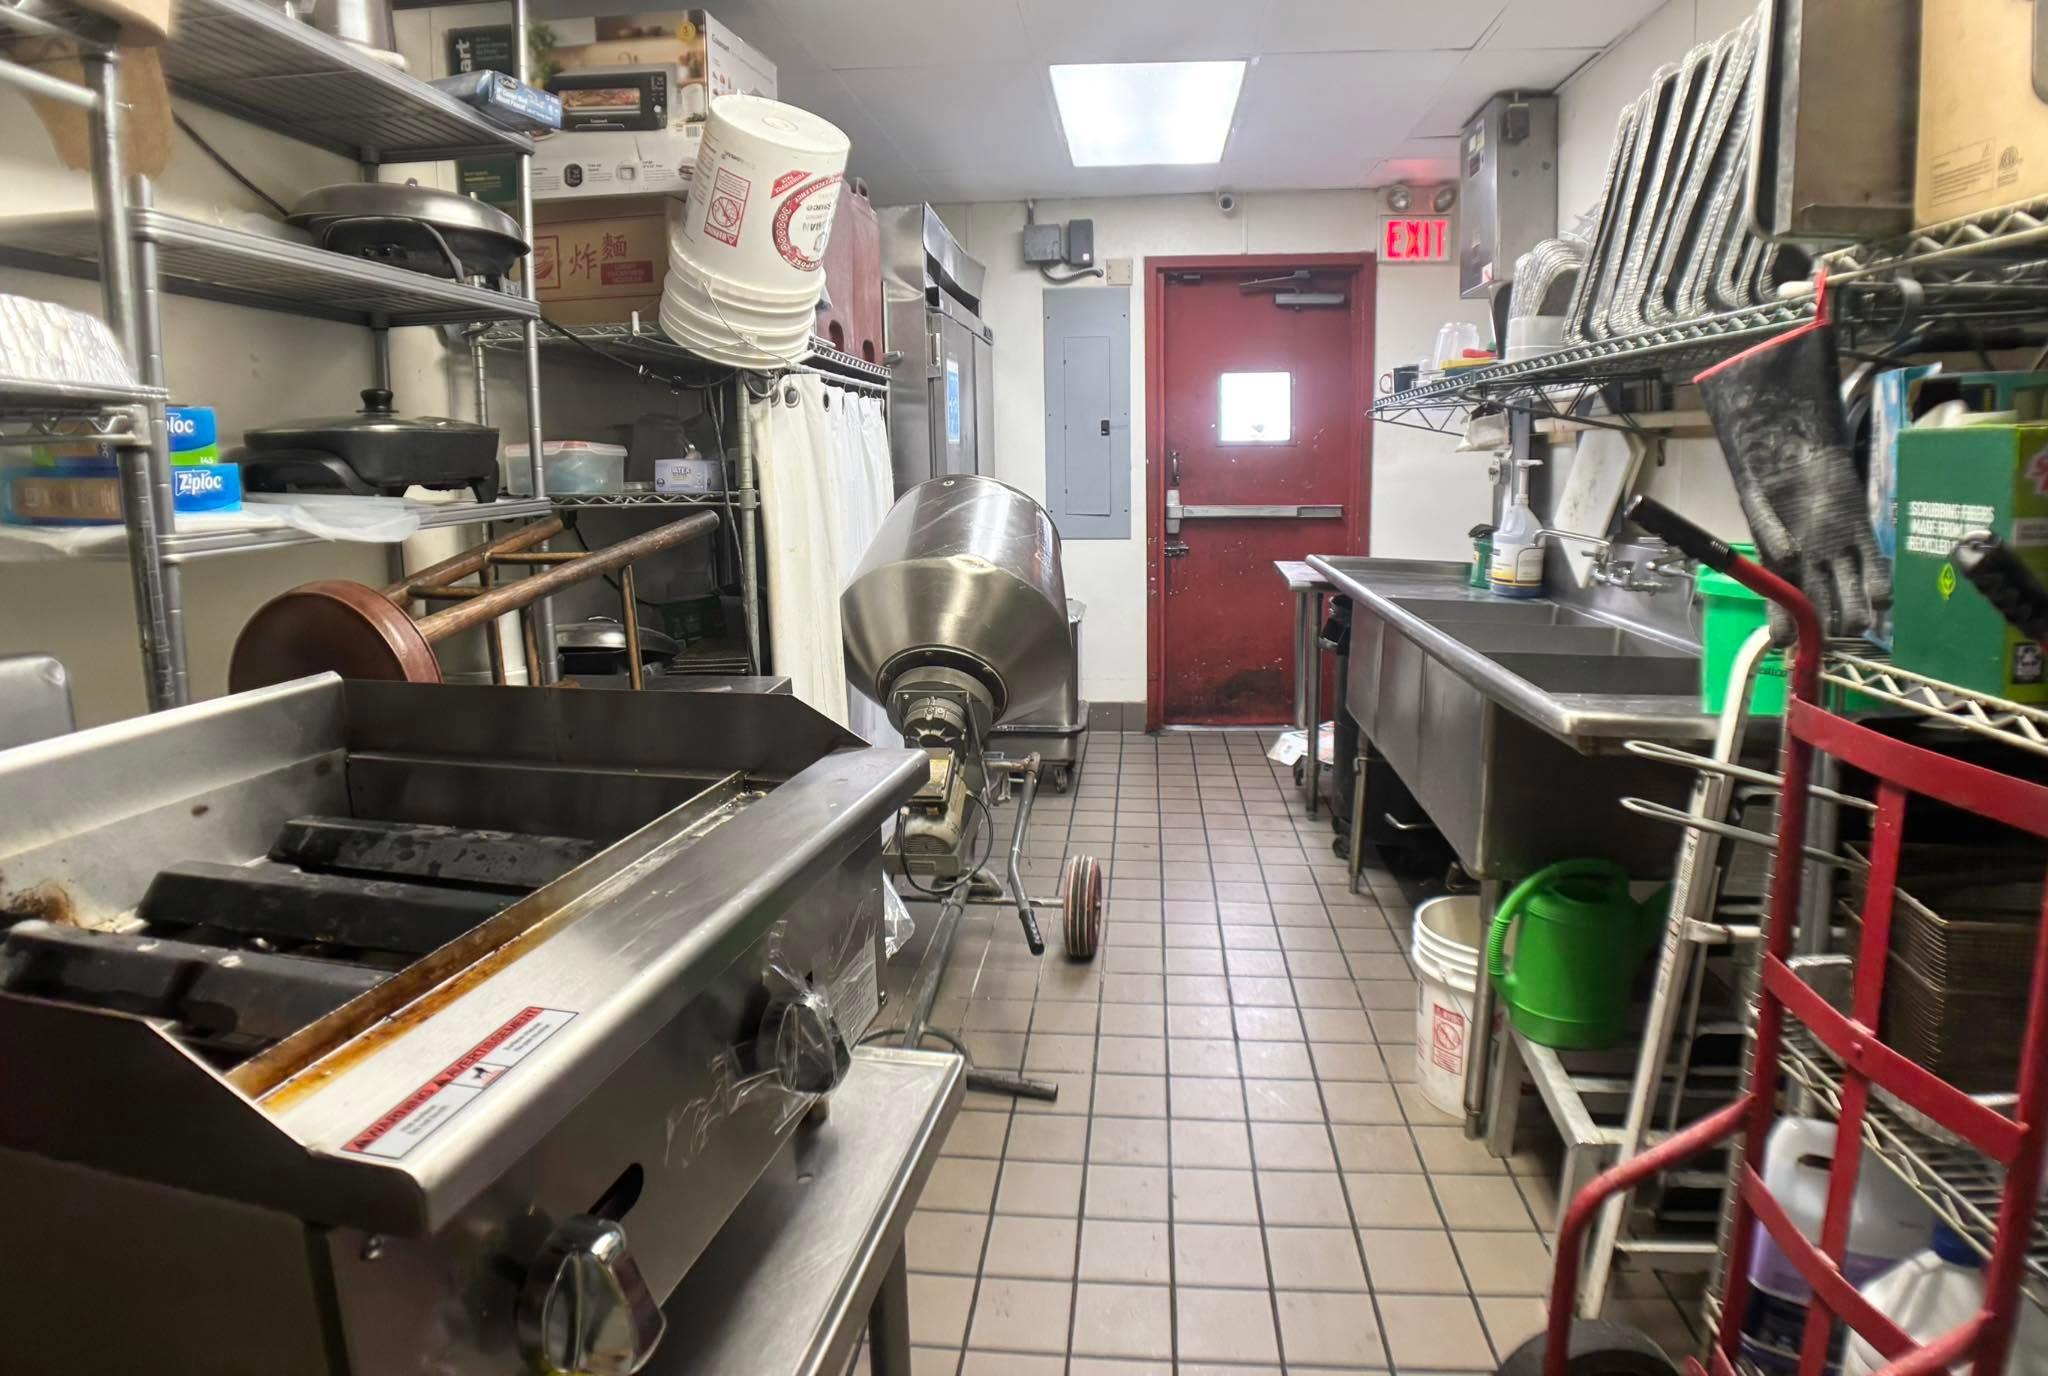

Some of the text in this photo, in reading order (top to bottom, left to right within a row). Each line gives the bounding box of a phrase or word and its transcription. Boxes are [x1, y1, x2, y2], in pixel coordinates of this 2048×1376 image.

[1386, 220, 1448, 260] EXIT
[179, 473, 222, 495] Ziploc
[1910, 500, 1961, 519] SCRUBBING
